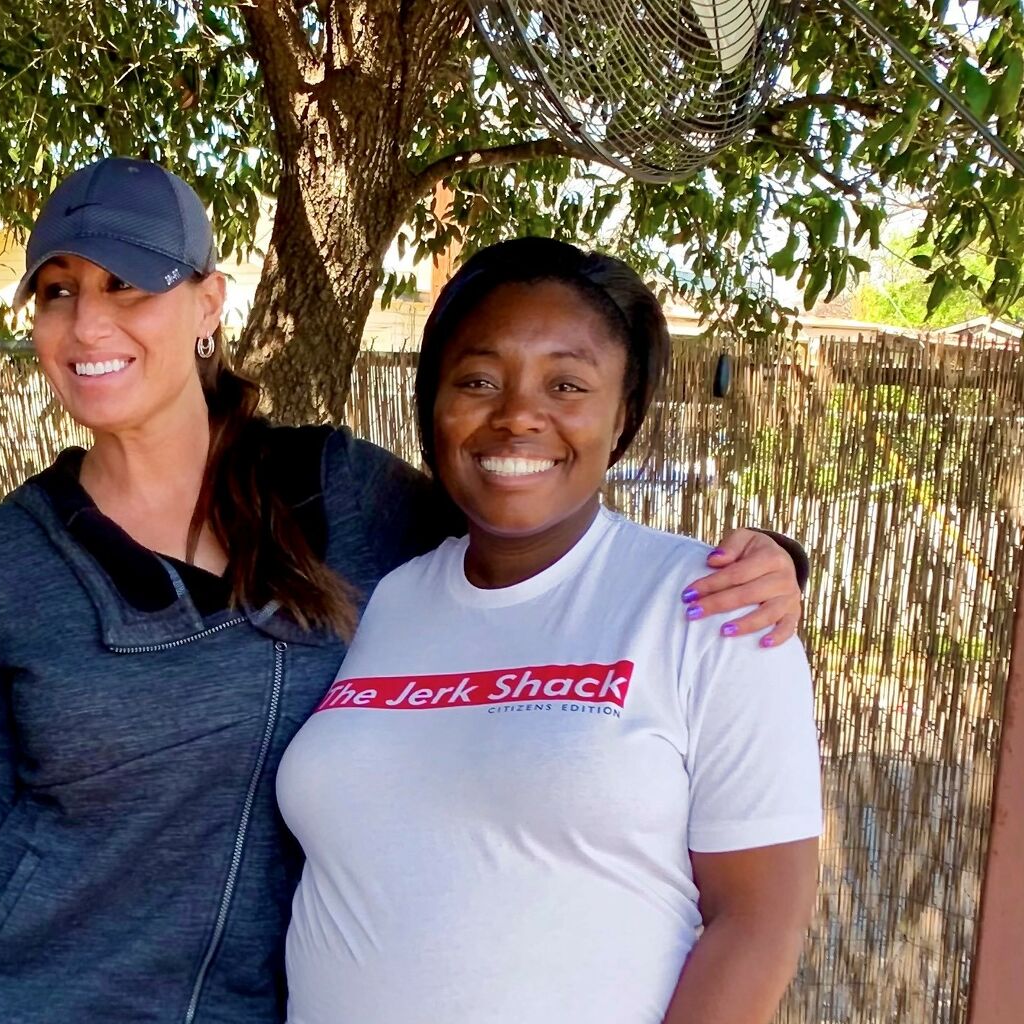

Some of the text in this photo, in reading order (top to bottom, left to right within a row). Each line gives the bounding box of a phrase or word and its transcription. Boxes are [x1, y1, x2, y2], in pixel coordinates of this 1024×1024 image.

[319, 670, 628, 709] The Jerk Shack
[487, 704, 621, 718] CITIZENS EDITION
